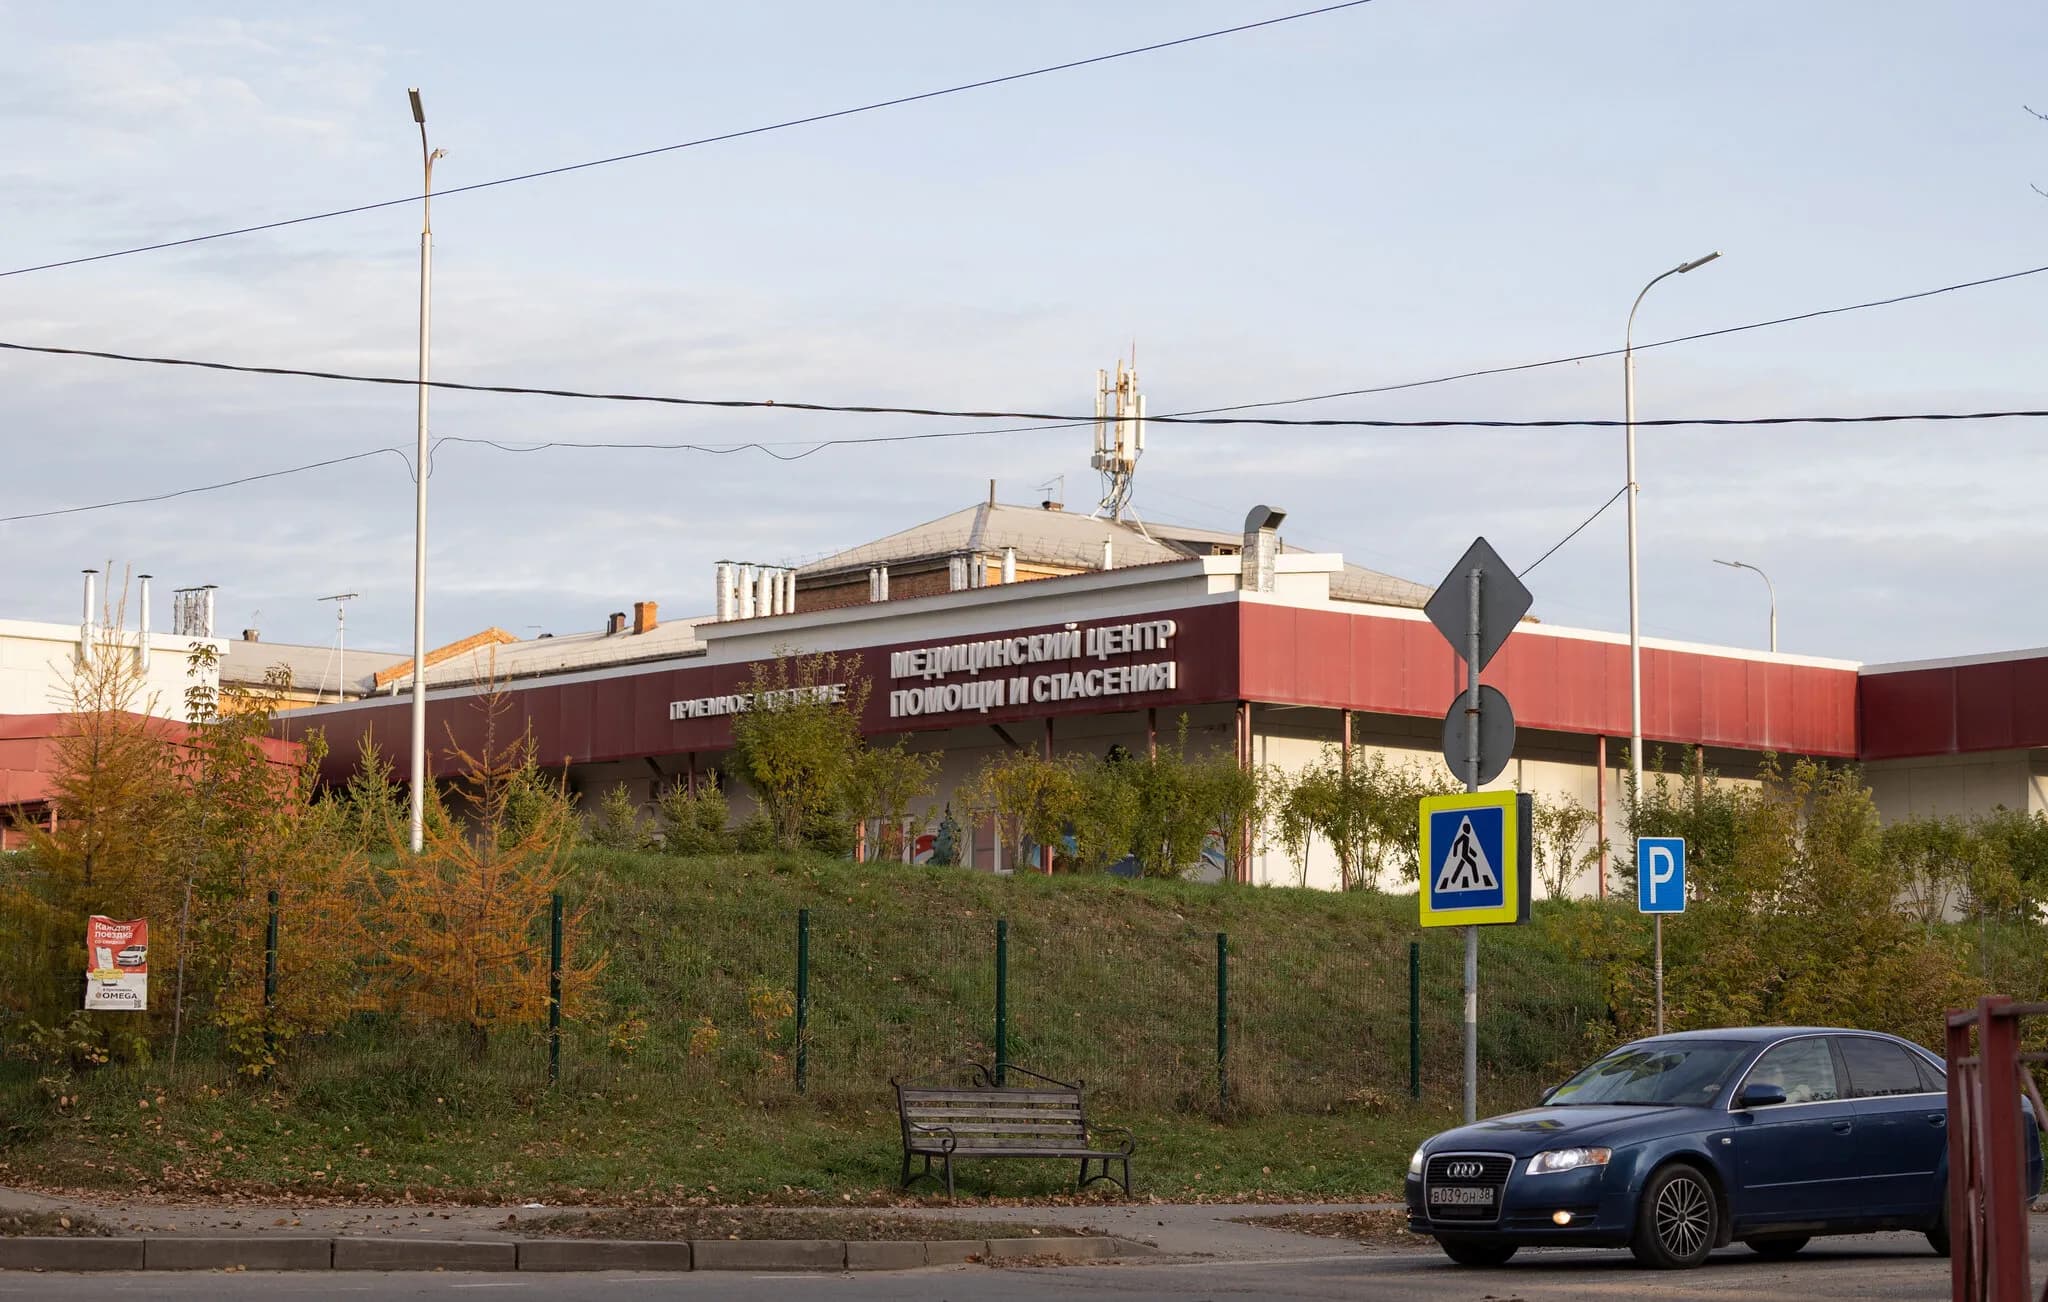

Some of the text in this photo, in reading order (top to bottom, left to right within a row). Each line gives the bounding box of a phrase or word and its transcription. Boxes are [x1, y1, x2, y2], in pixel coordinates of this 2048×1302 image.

[890, 619, 1177, 680] МЕДИЦИНСКИЙ ЦЕНТР
[669, 693, 754, 721] ПРИЕМНОЕ
[890, 661, 1177, 718] ПОМОЩИ И СПАСЕНИЯ
[1649, 846, 1675, 905] P
[95, 931, 133, 939] поездка
